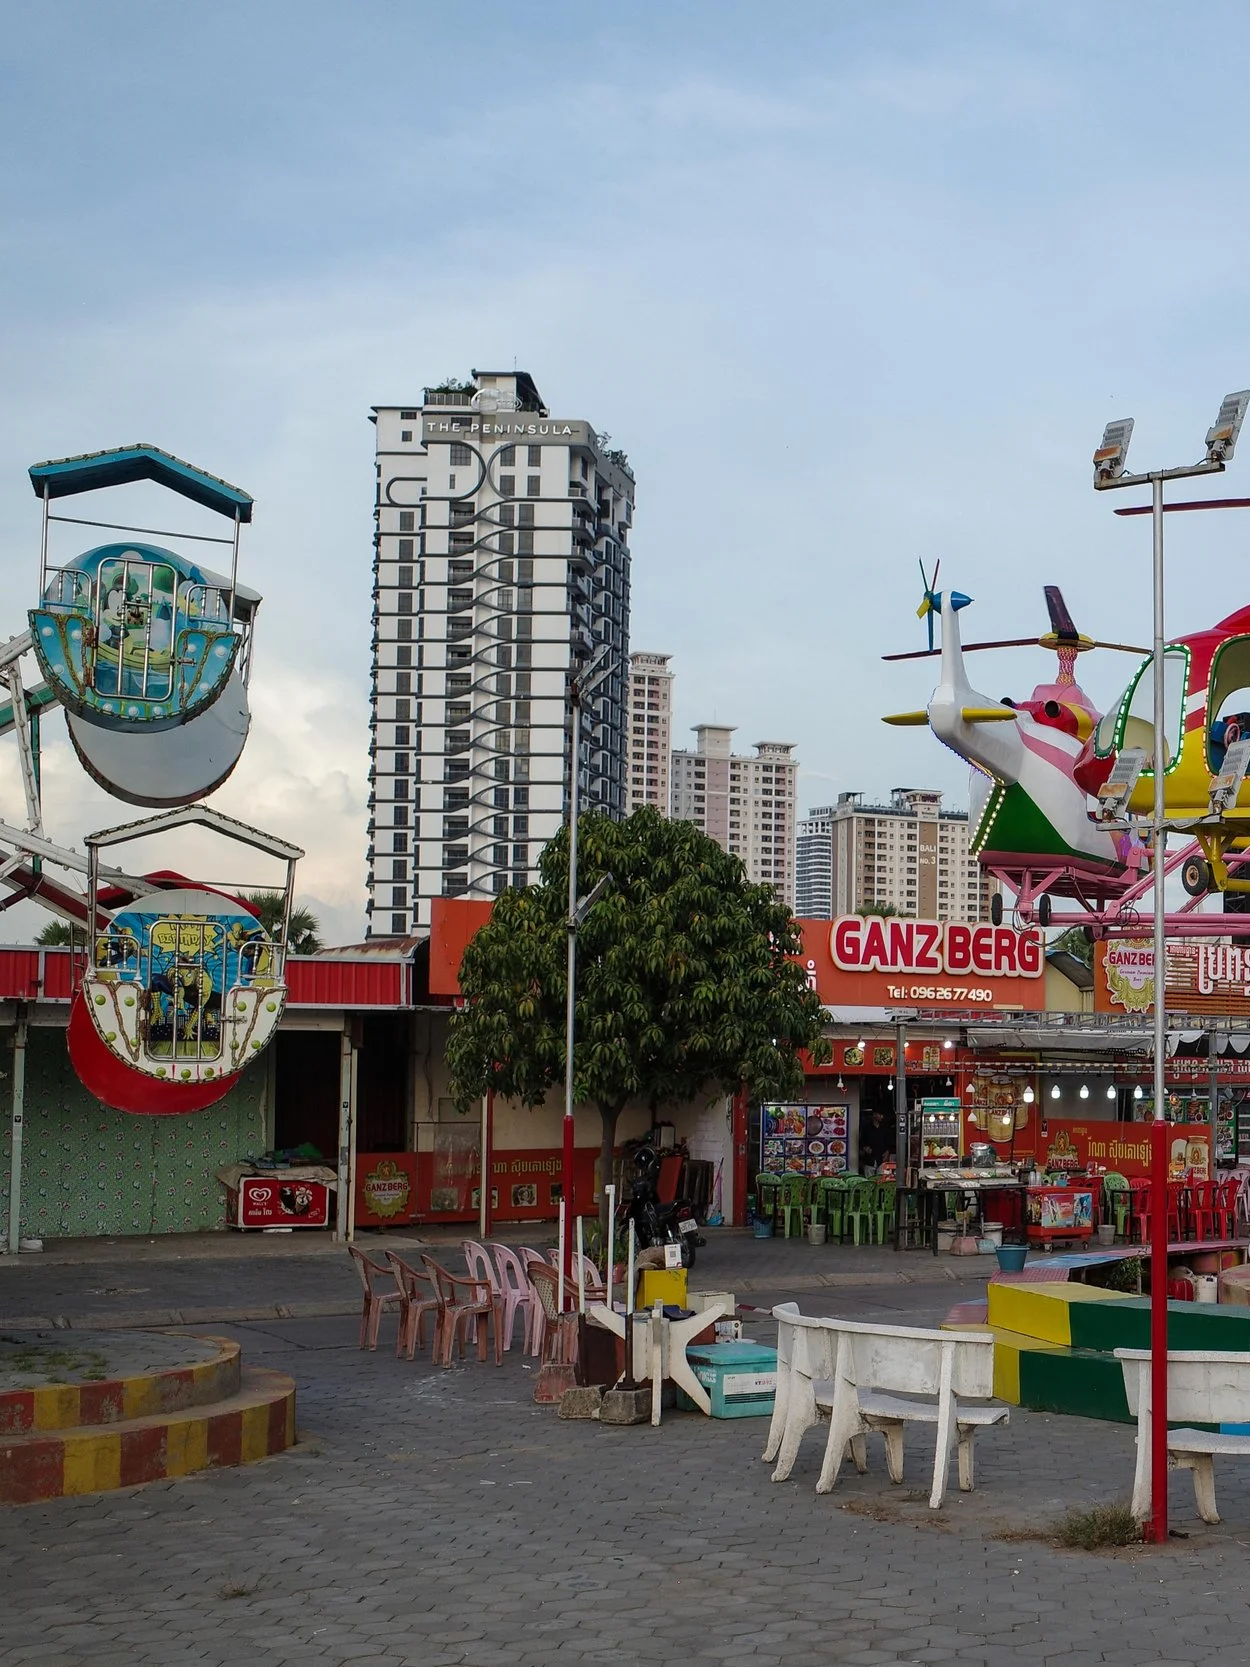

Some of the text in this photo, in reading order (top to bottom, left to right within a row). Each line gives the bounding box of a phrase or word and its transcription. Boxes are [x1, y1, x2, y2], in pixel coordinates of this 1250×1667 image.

[427, 422, 573, 435] THE PENINSULA
[920, 844, 937, 853] BALI
